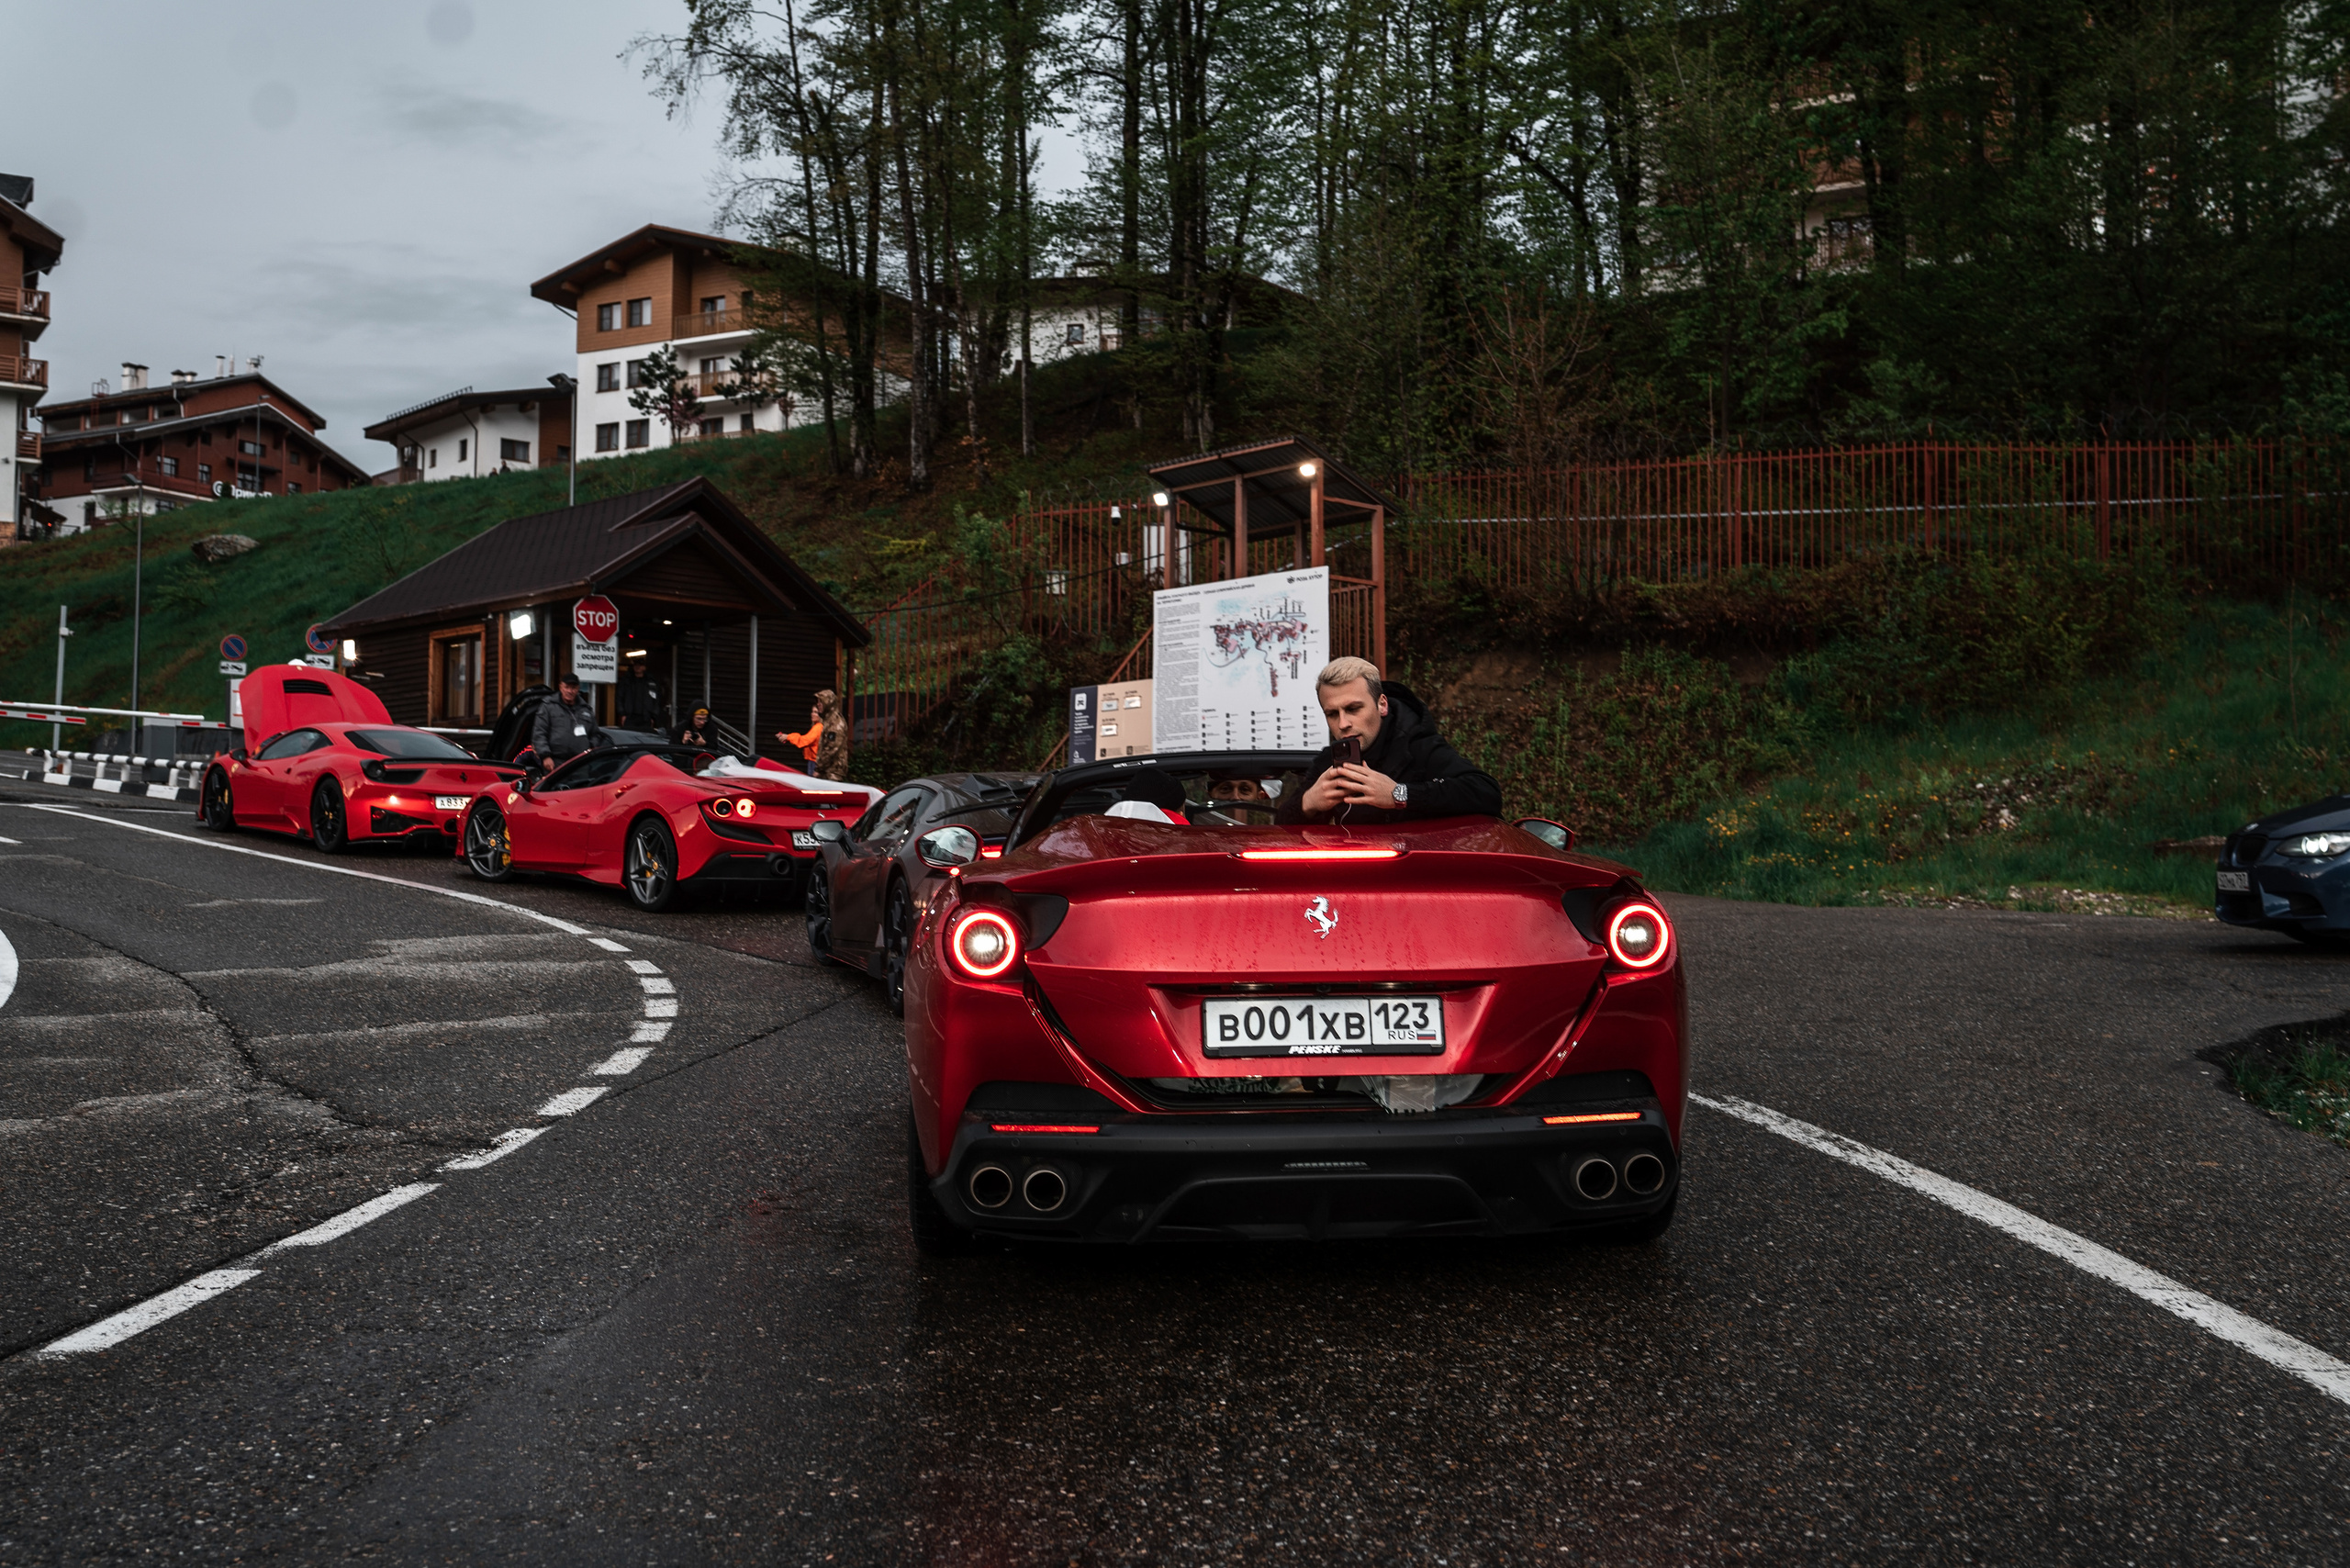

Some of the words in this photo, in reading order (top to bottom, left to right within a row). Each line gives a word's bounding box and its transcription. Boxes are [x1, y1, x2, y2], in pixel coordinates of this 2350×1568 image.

[577, 610, 616, 628] STOP
[601, 644, 616, 653] без
[581, 654, 614, 663] осмотра
[576, 663, 614, 671] запрещен
[1374, 1002, 1430, 1030] 123
[1387, 1029, 1416, 1041] RUS
[1288, 1045, 1342, 1055] PENSKE
